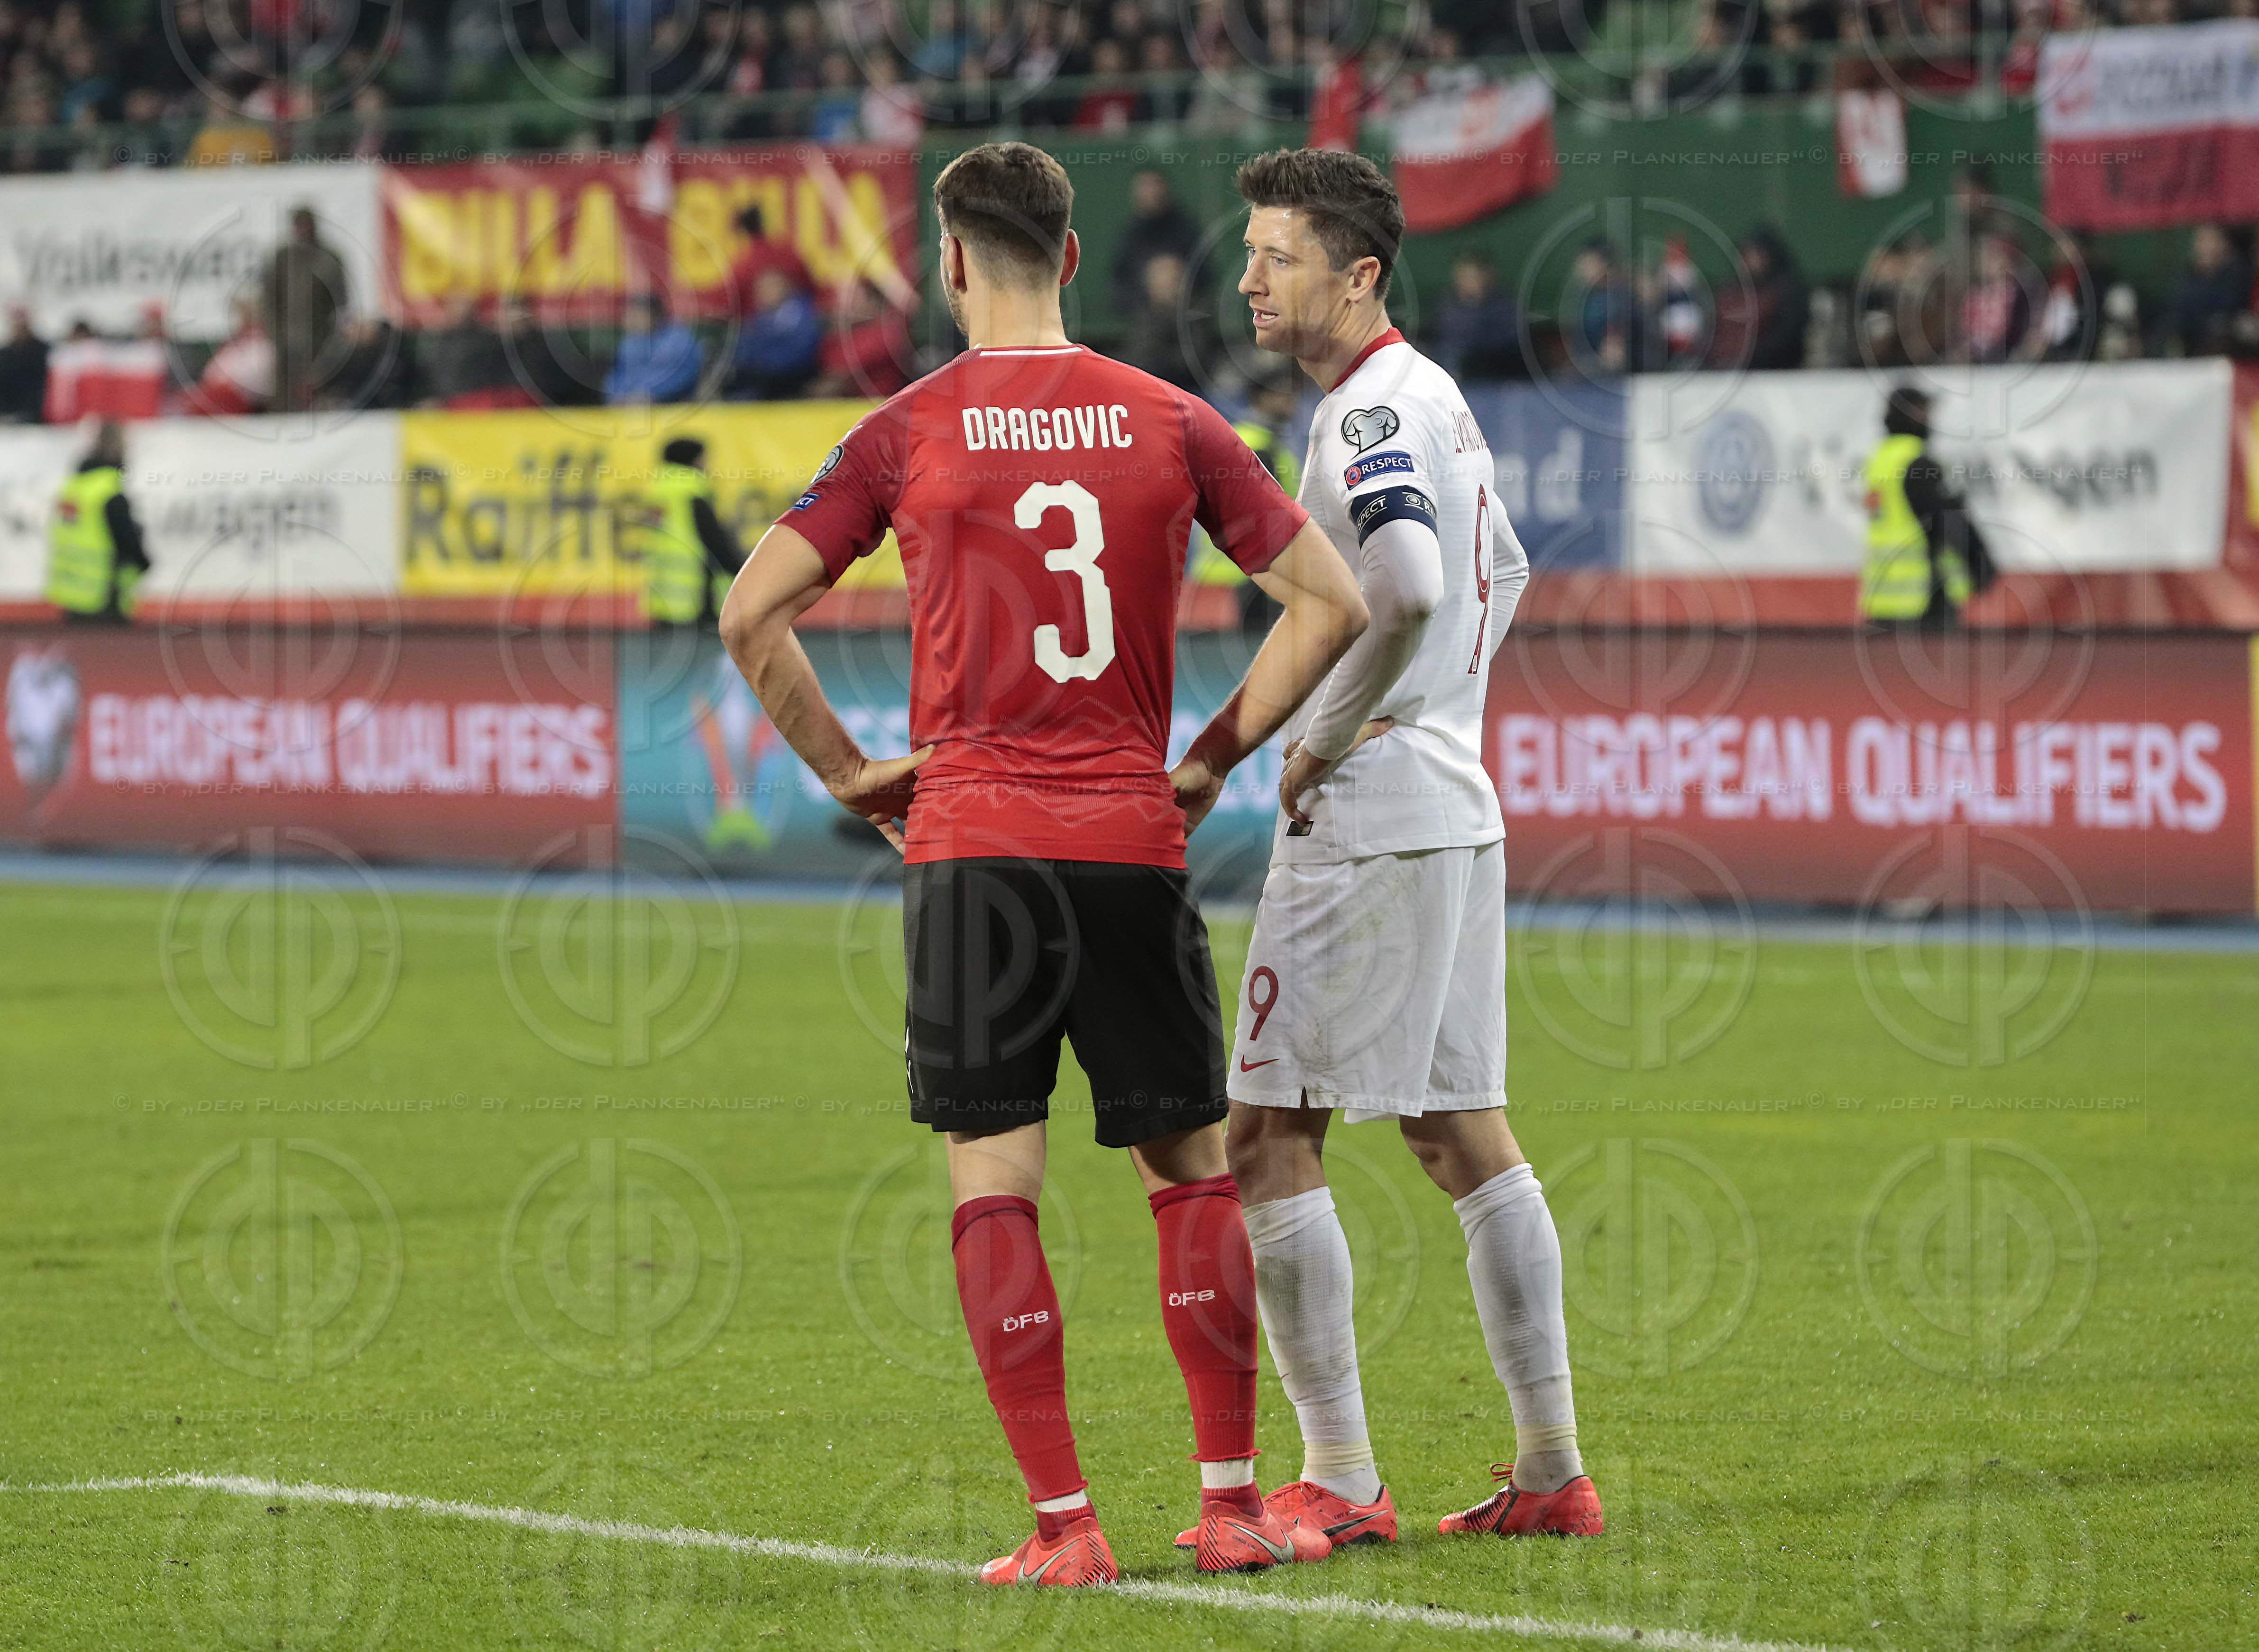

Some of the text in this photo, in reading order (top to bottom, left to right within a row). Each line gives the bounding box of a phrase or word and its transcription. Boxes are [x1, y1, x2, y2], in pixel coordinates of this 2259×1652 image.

[962, 404, 1133, 451] DRAGOVIC
[1361, 457, 1412, 475] RESPECT
[1013, 479, 1115, 683] 3
[89, 693, 611, 798] EUROPEAN QUALIFIERS
[1498, 713, 2228, 834] EUROPEAN QUALIFIERS
[1248, 965, 1279, 1041] 9
[1002, 1310, 1049, 1332] ÖFB
[1168, 1289, 1216, 1306] ÖFB
